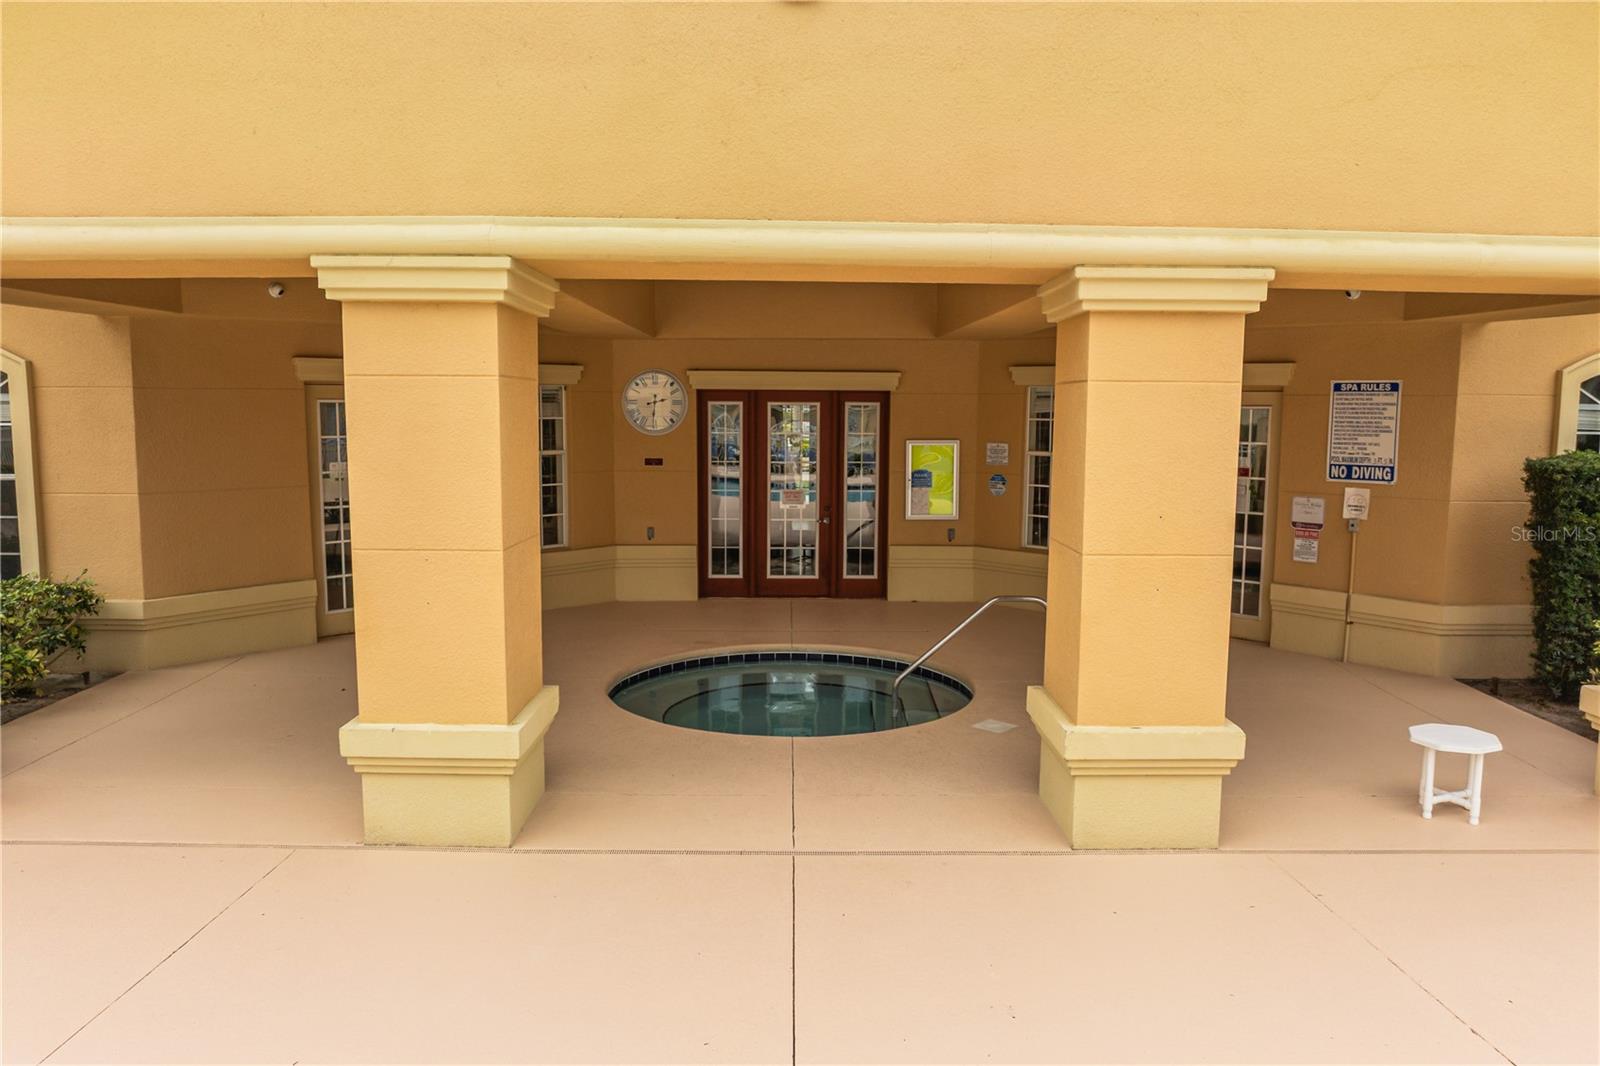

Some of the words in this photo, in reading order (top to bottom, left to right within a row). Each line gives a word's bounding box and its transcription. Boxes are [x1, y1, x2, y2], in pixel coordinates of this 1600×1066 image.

[1340, 383, 1358, 391] SPA
[1360, 383, 1391, 391] RULES
[1331, 466, 1347, 478] NO
[1352, 467, 1392, 480] DIVING
